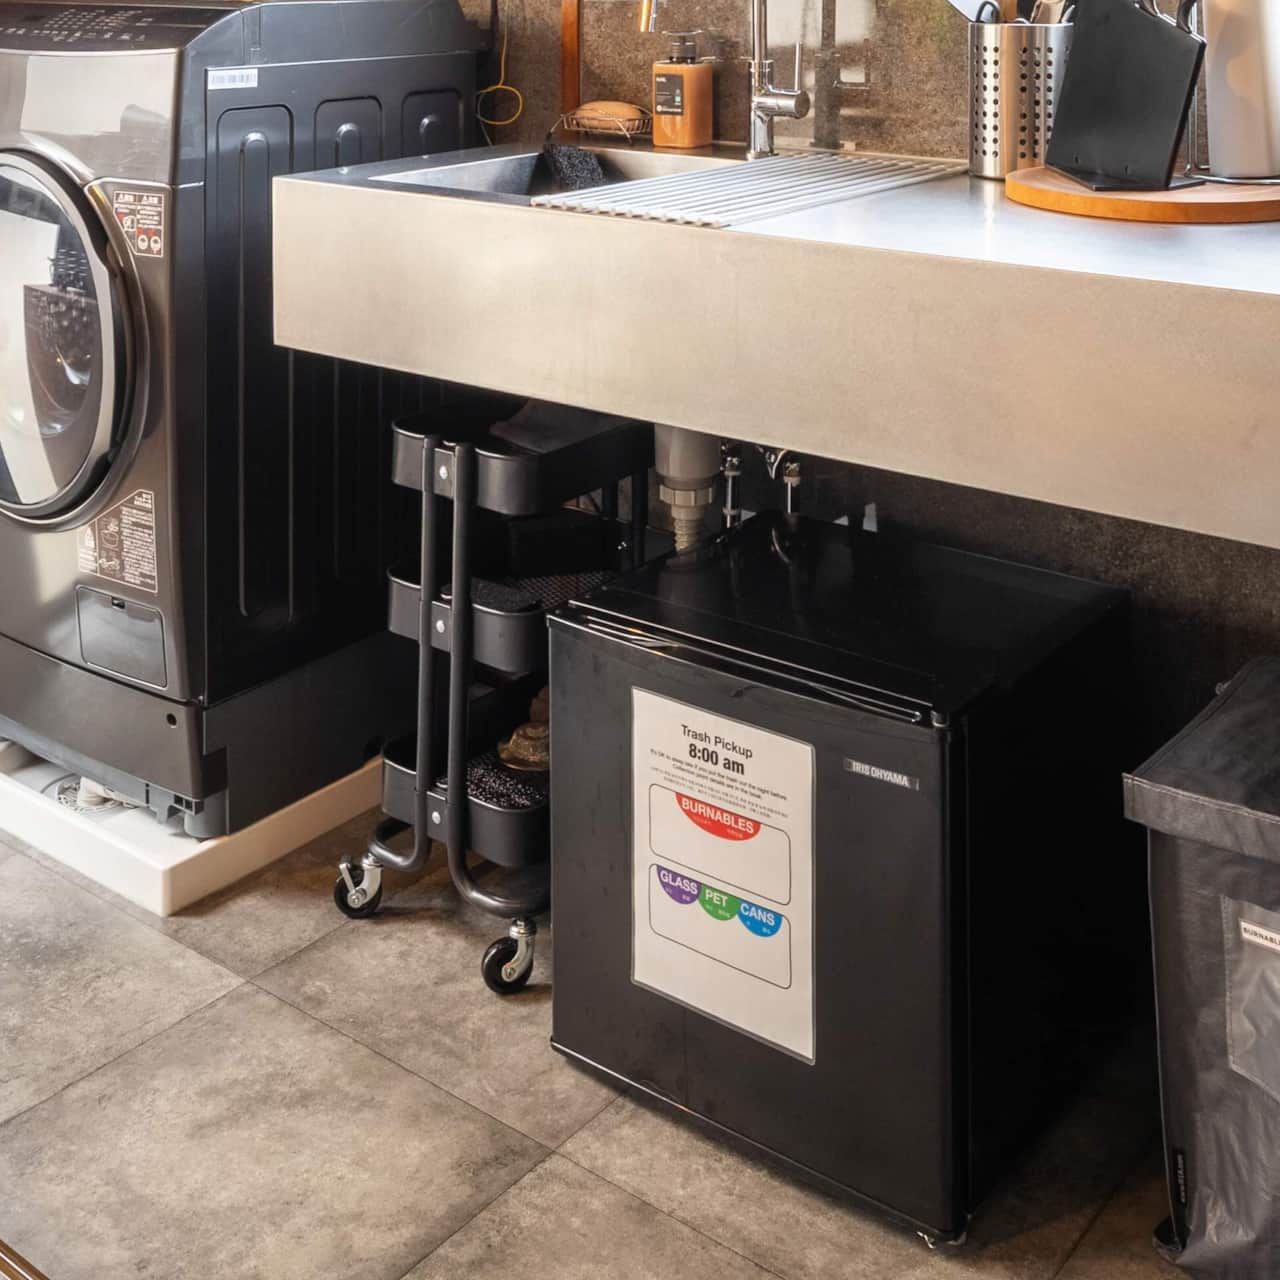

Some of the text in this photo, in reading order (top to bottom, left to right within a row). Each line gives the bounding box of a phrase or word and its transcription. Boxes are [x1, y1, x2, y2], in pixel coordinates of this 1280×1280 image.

[681, 724, 753, 759] Trash Pickup
[689, 743, 745, 775] 8:00 am
[852, 761, 911, 789] IRIS OHYAMA
[681, 798, 754, 834] BURNABLES
[660, 870, 698, 895] GLASS
[705, 889, 728, 907] PET
[740, 903, 775, 926] CANS
